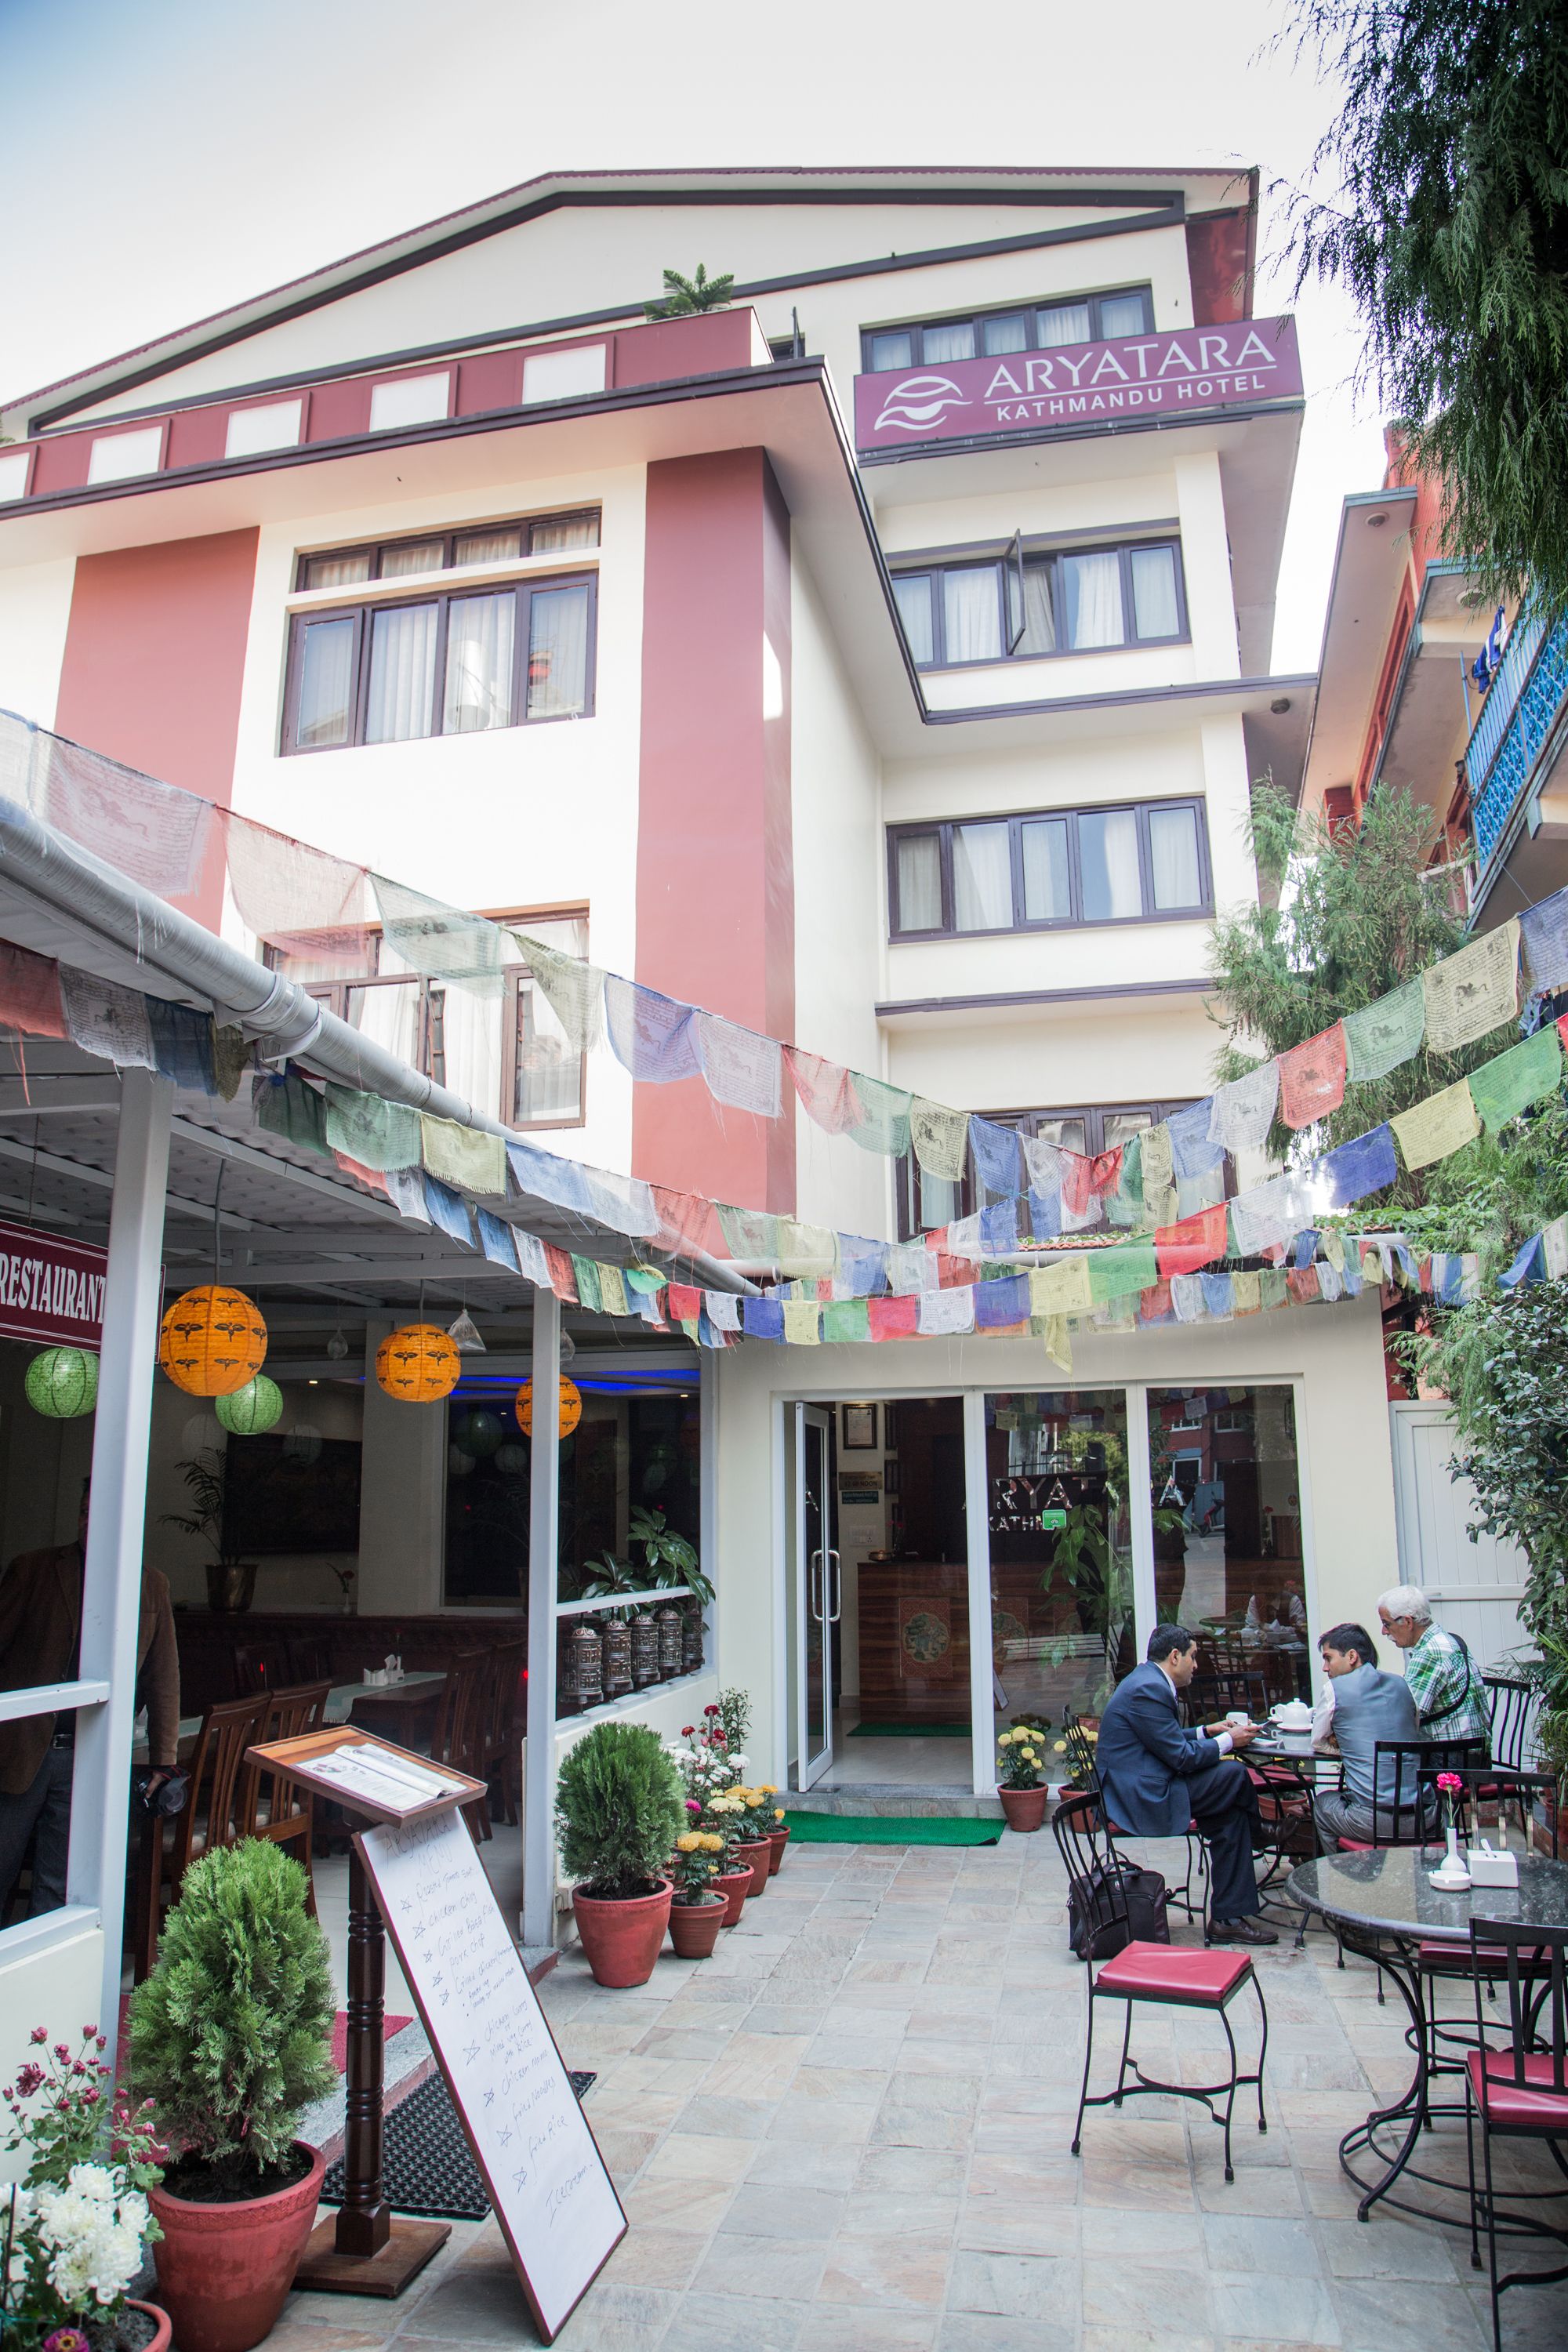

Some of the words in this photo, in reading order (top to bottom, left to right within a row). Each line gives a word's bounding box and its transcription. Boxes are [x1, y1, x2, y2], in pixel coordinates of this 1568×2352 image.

[983, 329, 1277, 398] ARYATARA
[996, 387, 1163, 422] KATHMANDU
[1178, 375, 1266, 400] HOTEL
[0, 1252, 106, 1324] RESTAURANT
